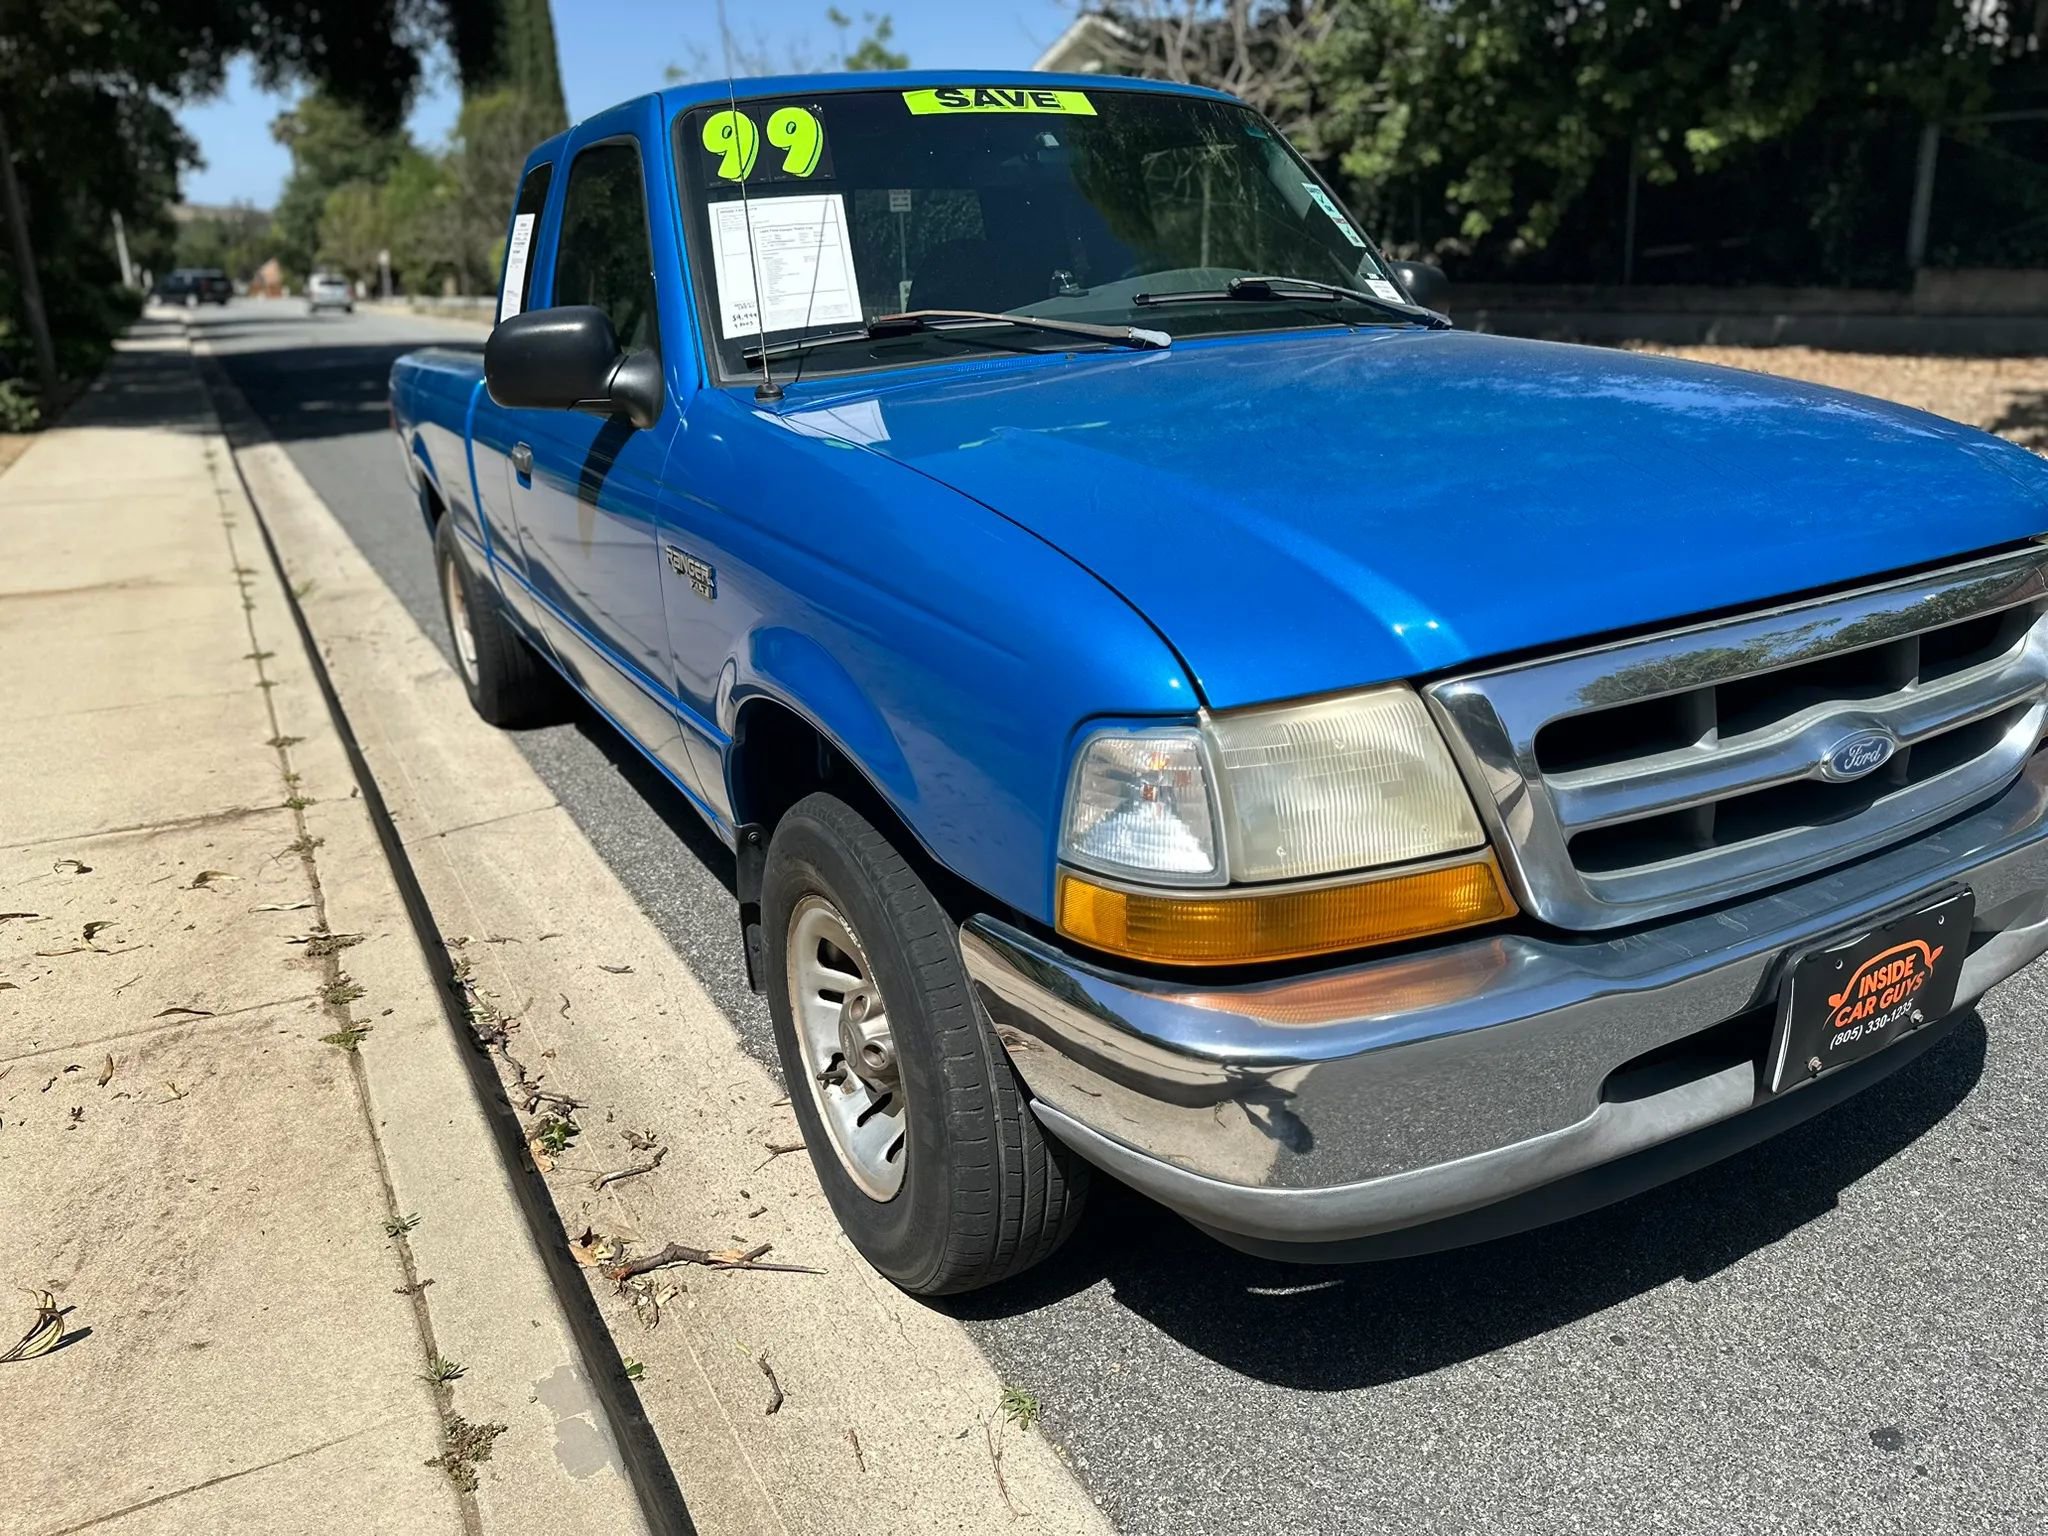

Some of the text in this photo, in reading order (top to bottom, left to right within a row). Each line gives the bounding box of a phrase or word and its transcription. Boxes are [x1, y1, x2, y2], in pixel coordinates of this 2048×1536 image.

[934, 88, 1066, 110] SAVE
[702, 106, 824, 182] 99
[665, 546, 714, 587] RANGER
[691, 580, 708, 595] XLT
[1844, 738, 1883, 770] Ford
[1858, 953, 1917, 999] INSIDE
[1834, 970, 1926, 1028] CAR GUYS
[1829, 997, 1914, 1051] (805) 330-1235
